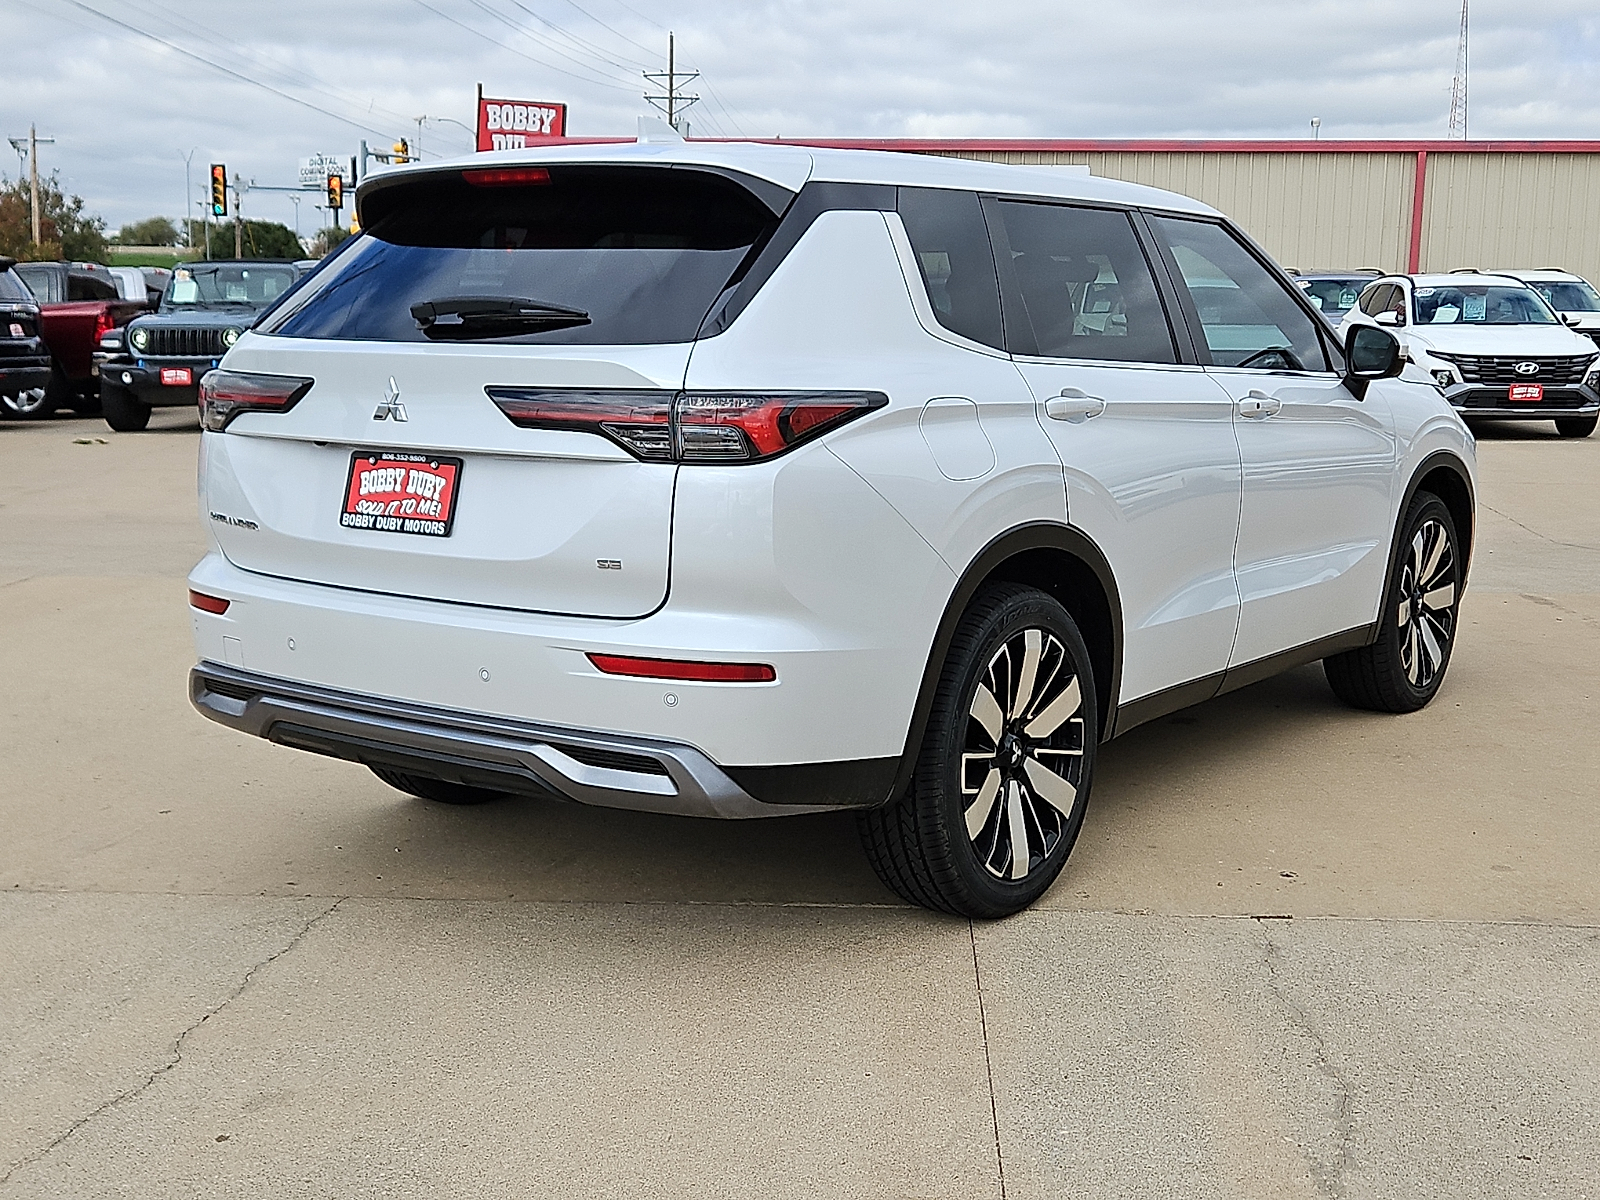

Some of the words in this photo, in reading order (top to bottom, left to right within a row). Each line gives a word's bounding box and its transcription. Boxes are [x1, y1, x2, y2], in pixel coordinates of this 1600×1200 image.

[486, 104, 556, 133] BOBBY
[309, 157, 337, 166] DIGITAL
[301, 167, 325, 175] COMING
[360, 468, 405, 495] BOBBY
[406, 469, 446, 500] DUBY
[355, 500, 385, 515] SOLD
[385, 500, 400, 516] IT
[400, 499, 416, 515] TO
[417, 499, 442, 517] ME!
[342, 513, 375, 527] BOBBY
[376, 517, 402, 530] DUBY
[404, 519, 446, 534] MOTORS
[596, 560, 622, 569] SE
